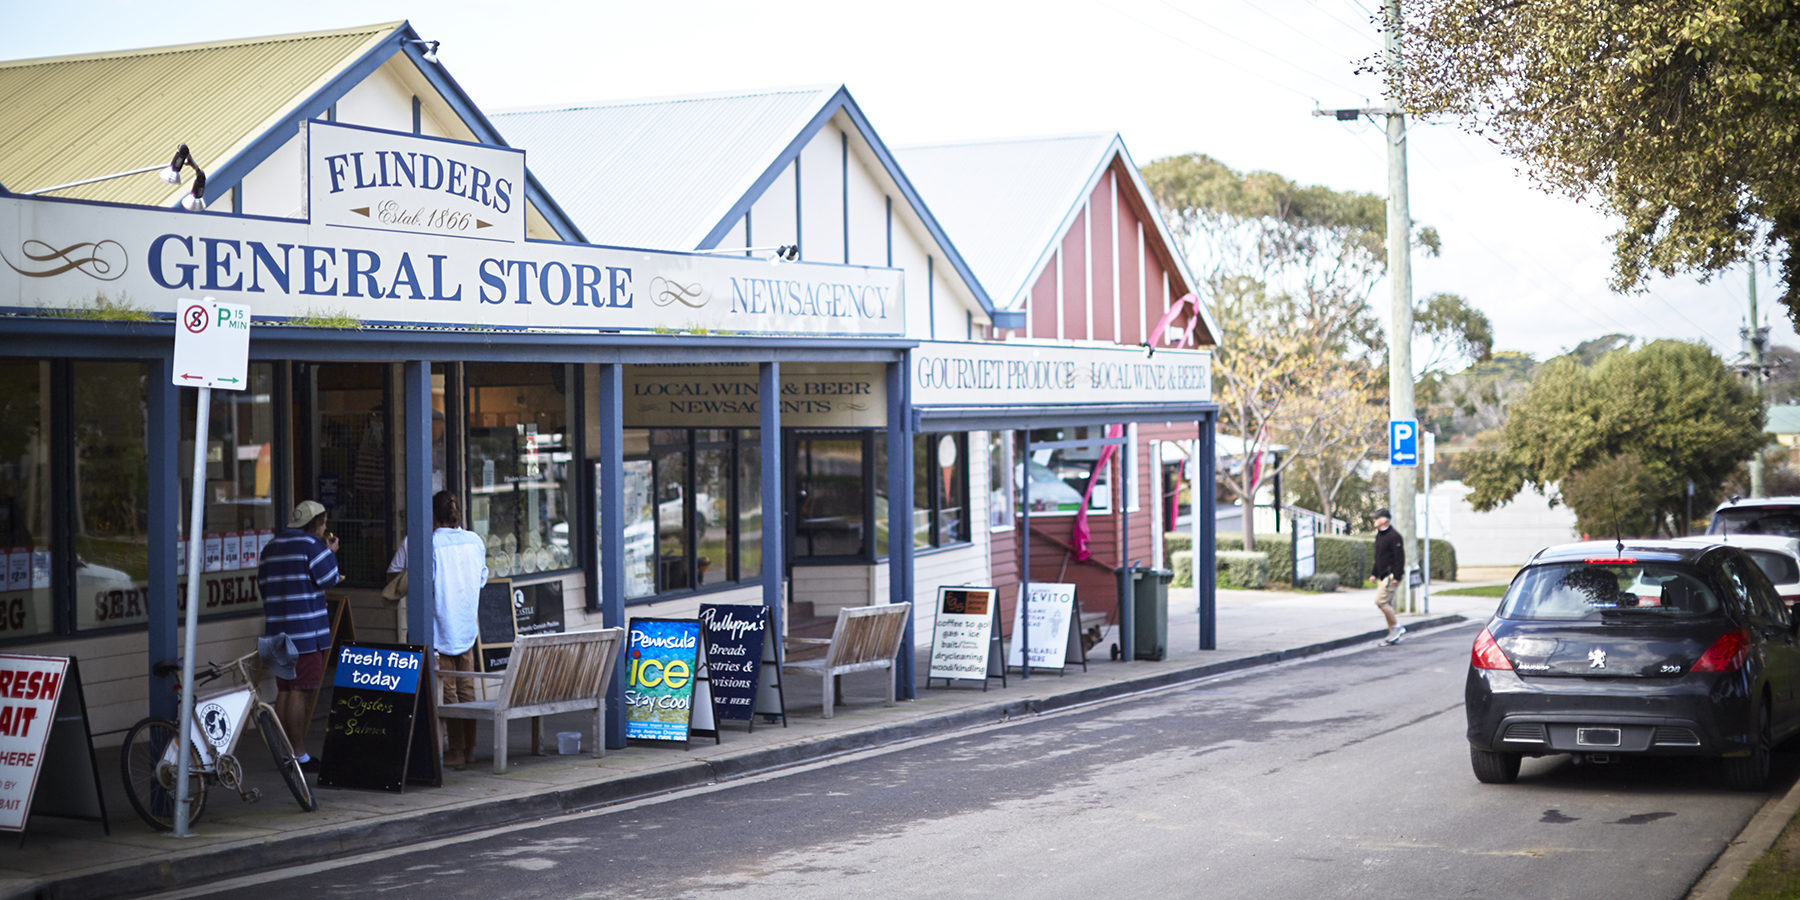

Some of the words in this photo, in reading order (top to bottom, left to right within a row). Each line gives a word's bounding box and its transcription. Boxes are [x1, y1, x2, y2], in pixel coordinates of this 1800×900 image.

[324, 151, 512, 214] FLINDERS
[377, 199, 422, 227] Estab.
[427, 208, 472, 231] 1866
[147, 233, 462, 302] GENERAL
[479, 258, 633, 309] STORE
[730, 277, 890, 319] NEWSAGENCY
[217, 308, 231, 328] P
[235, 310, 244, 319] 15
[229, 320, 247, 330] MIN
[918, 357, 1004, 389] GOURMET
[1007, 360, 1075, 389] PRODUCE
[1091, 362, 1132, 389] LOCAL
[1133, 364, 1166, 390] WINE
[1167, 365, 1176, 390] &
[1178, 365, 1206, 390] BEER
[634, 383, 708, 396] LOCAL
[711, 383, 760, 396] WIN
[781, 383, 799, 395] &
[804, 382, 872, 396] BEER
[1395, 424, 1412, 450] P
[206, 575, 258, 608] DELI
[937, 619, 963, 628] coffee
[630, 630, 696, 649] Peninsula
[942, 630, 958, 639] gas
[968, 630, 980, 638] ice
[341, 648, 382, 667] fresh
[387, 652, 418, 670] fish
[709, 643, 747, 656] Breads
[935, 652, 983, 663] drycleaning
[629, 649, 691, 689] ice
[710, 661, 741, 672] stries
[743, 661, 753, 672] &
[0, 670, 60, 700] RESH
[352, 670, 401, 690] today
[711, 676, 752, 688] visions
[625, 690, 656, 713] Stay
[658, 695, 690, 709] Cool
[730, 697, 751, 705] HERE
[0, 706, 37, 737] AIT
[4, 780, 17, 790] BY
